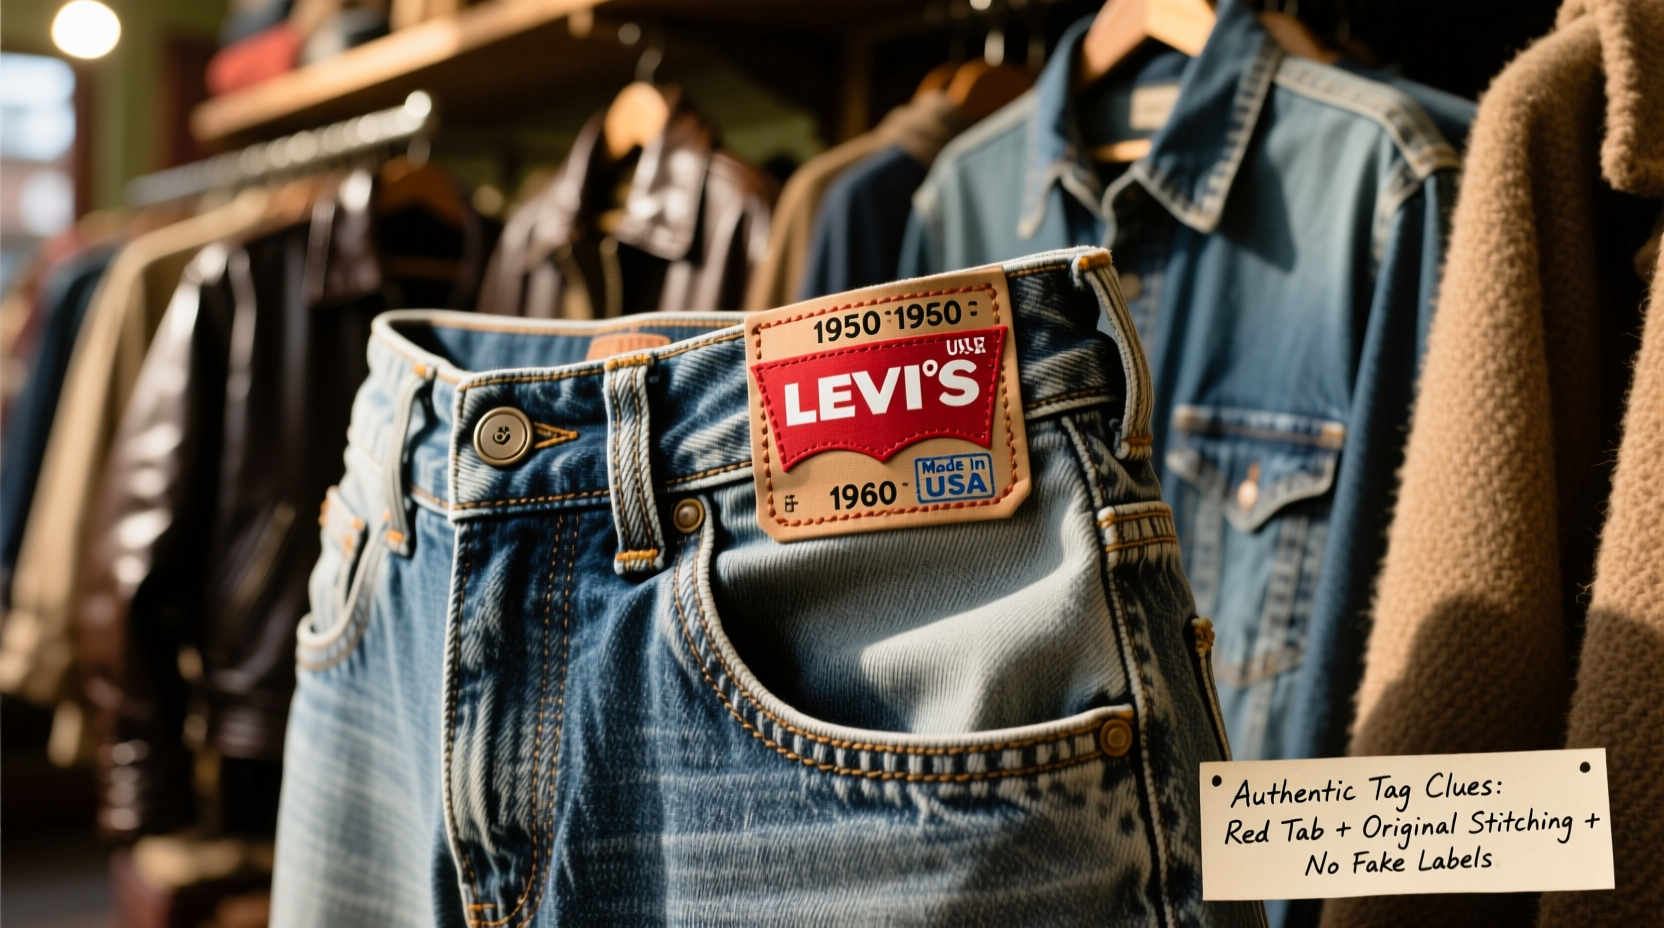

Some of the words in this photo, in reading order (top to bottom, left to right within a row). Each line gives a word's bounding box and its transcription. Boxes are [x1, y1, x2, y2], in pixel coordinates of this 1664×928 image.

[813, 311, 880, 343] 1950
[894, 300, 961, 330] 1950
[829, 480, 897, 511] 1960
[925, 474, 988, 497] USA
[1230, 779, 1357, 809] Authentic
[1369, 775, 1411, 812] Tag
[1425, 772, 1503, 798] Clues:
[1224, 819, 1270, 845] Red
[1281, 818, 1325, 842] Tab
[1362, 811, 1458, 850] Original
[1468, 807, 1574, 844] Stitching
[1304, 850, 1340, 876] No
[1353, 850, 1406, 874] Fake
[1418, 845, 1493, 871] Labels
